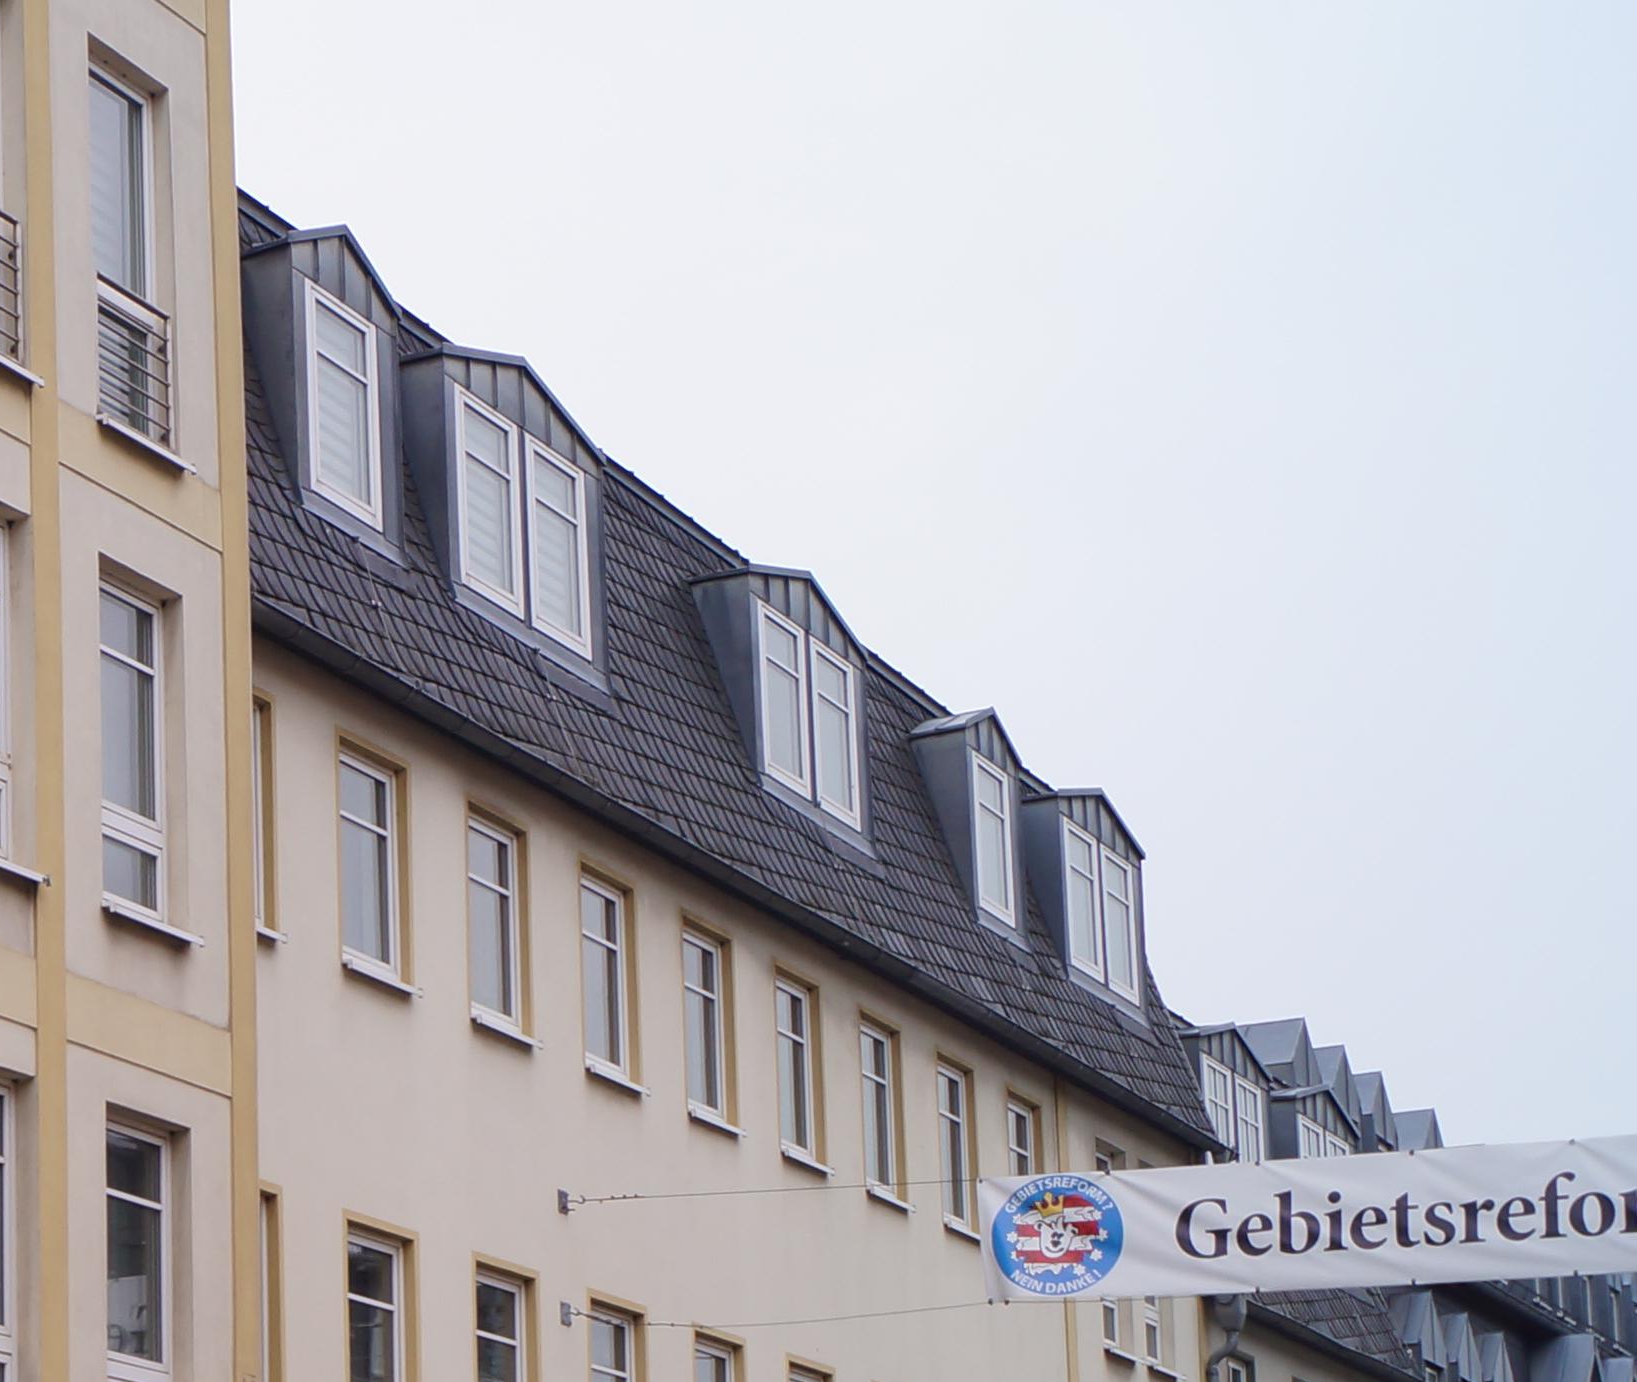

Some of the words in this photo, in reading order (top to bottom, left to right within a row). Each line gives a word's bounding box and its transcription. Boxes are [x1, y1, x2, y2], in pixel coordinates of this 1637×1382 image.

[1005, 1176, 1107, 1214] GEBIETSREFORM
[1010, 1269, 1043, 1292] NEIN
[1045, 1273, 1096, 1294] DANKE
